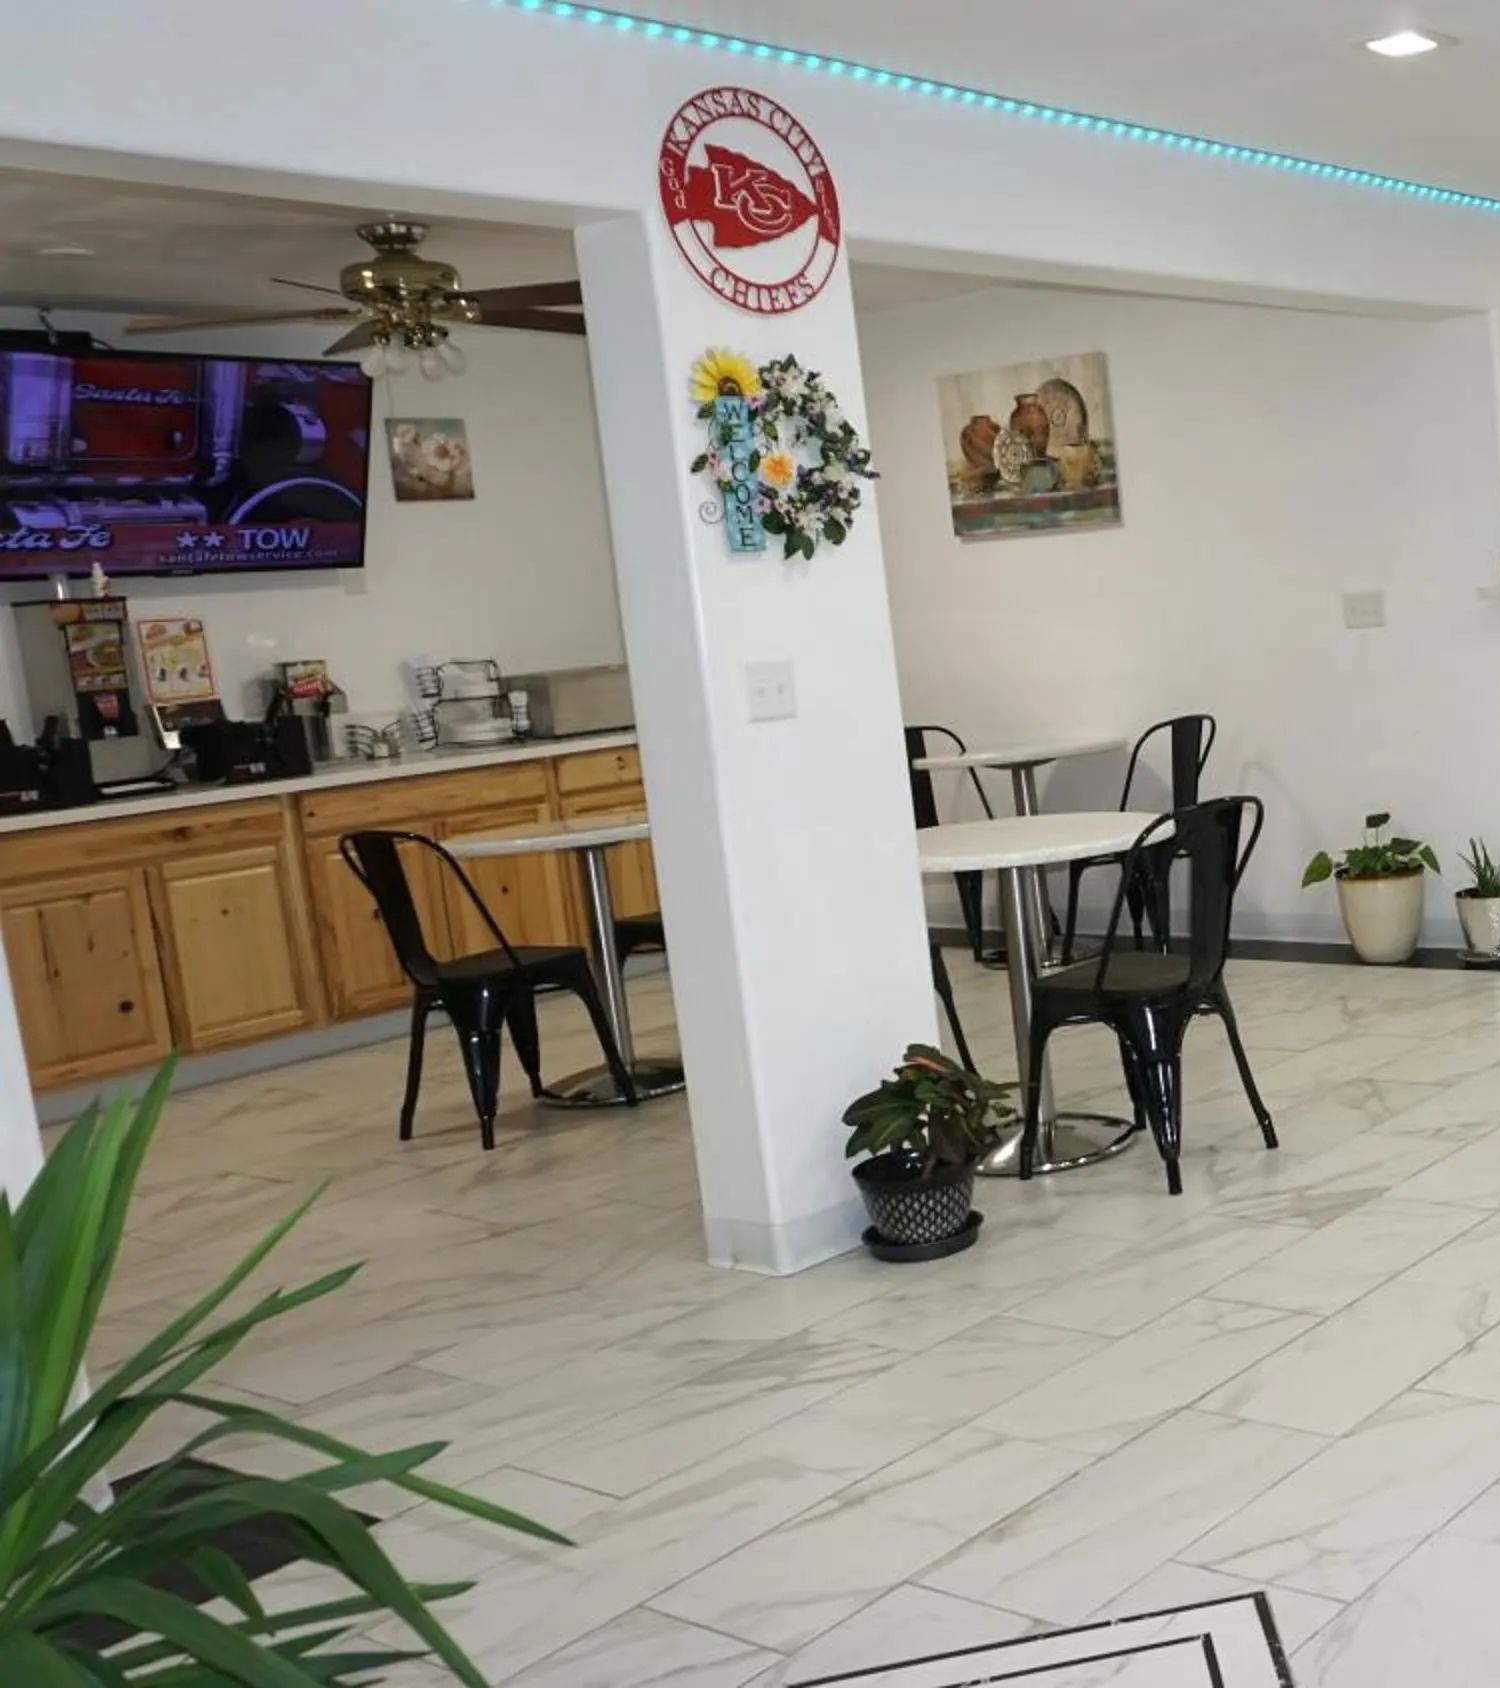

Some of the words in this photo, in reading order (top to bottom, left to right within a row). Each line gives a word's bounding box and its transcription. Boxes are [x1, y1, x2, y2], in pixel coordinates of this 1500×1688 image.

[664, 88, 761, 153] KANSAS
[769, 106, 825, 172] CITY
[710, 267, 815, 312] CHIEFS
[76, 383, 152, 403] Santa
[723, 402, 756, 547] WELCOME
[59, 524, 111, 548] Fe
[238, 528, 310, 549] TOW
